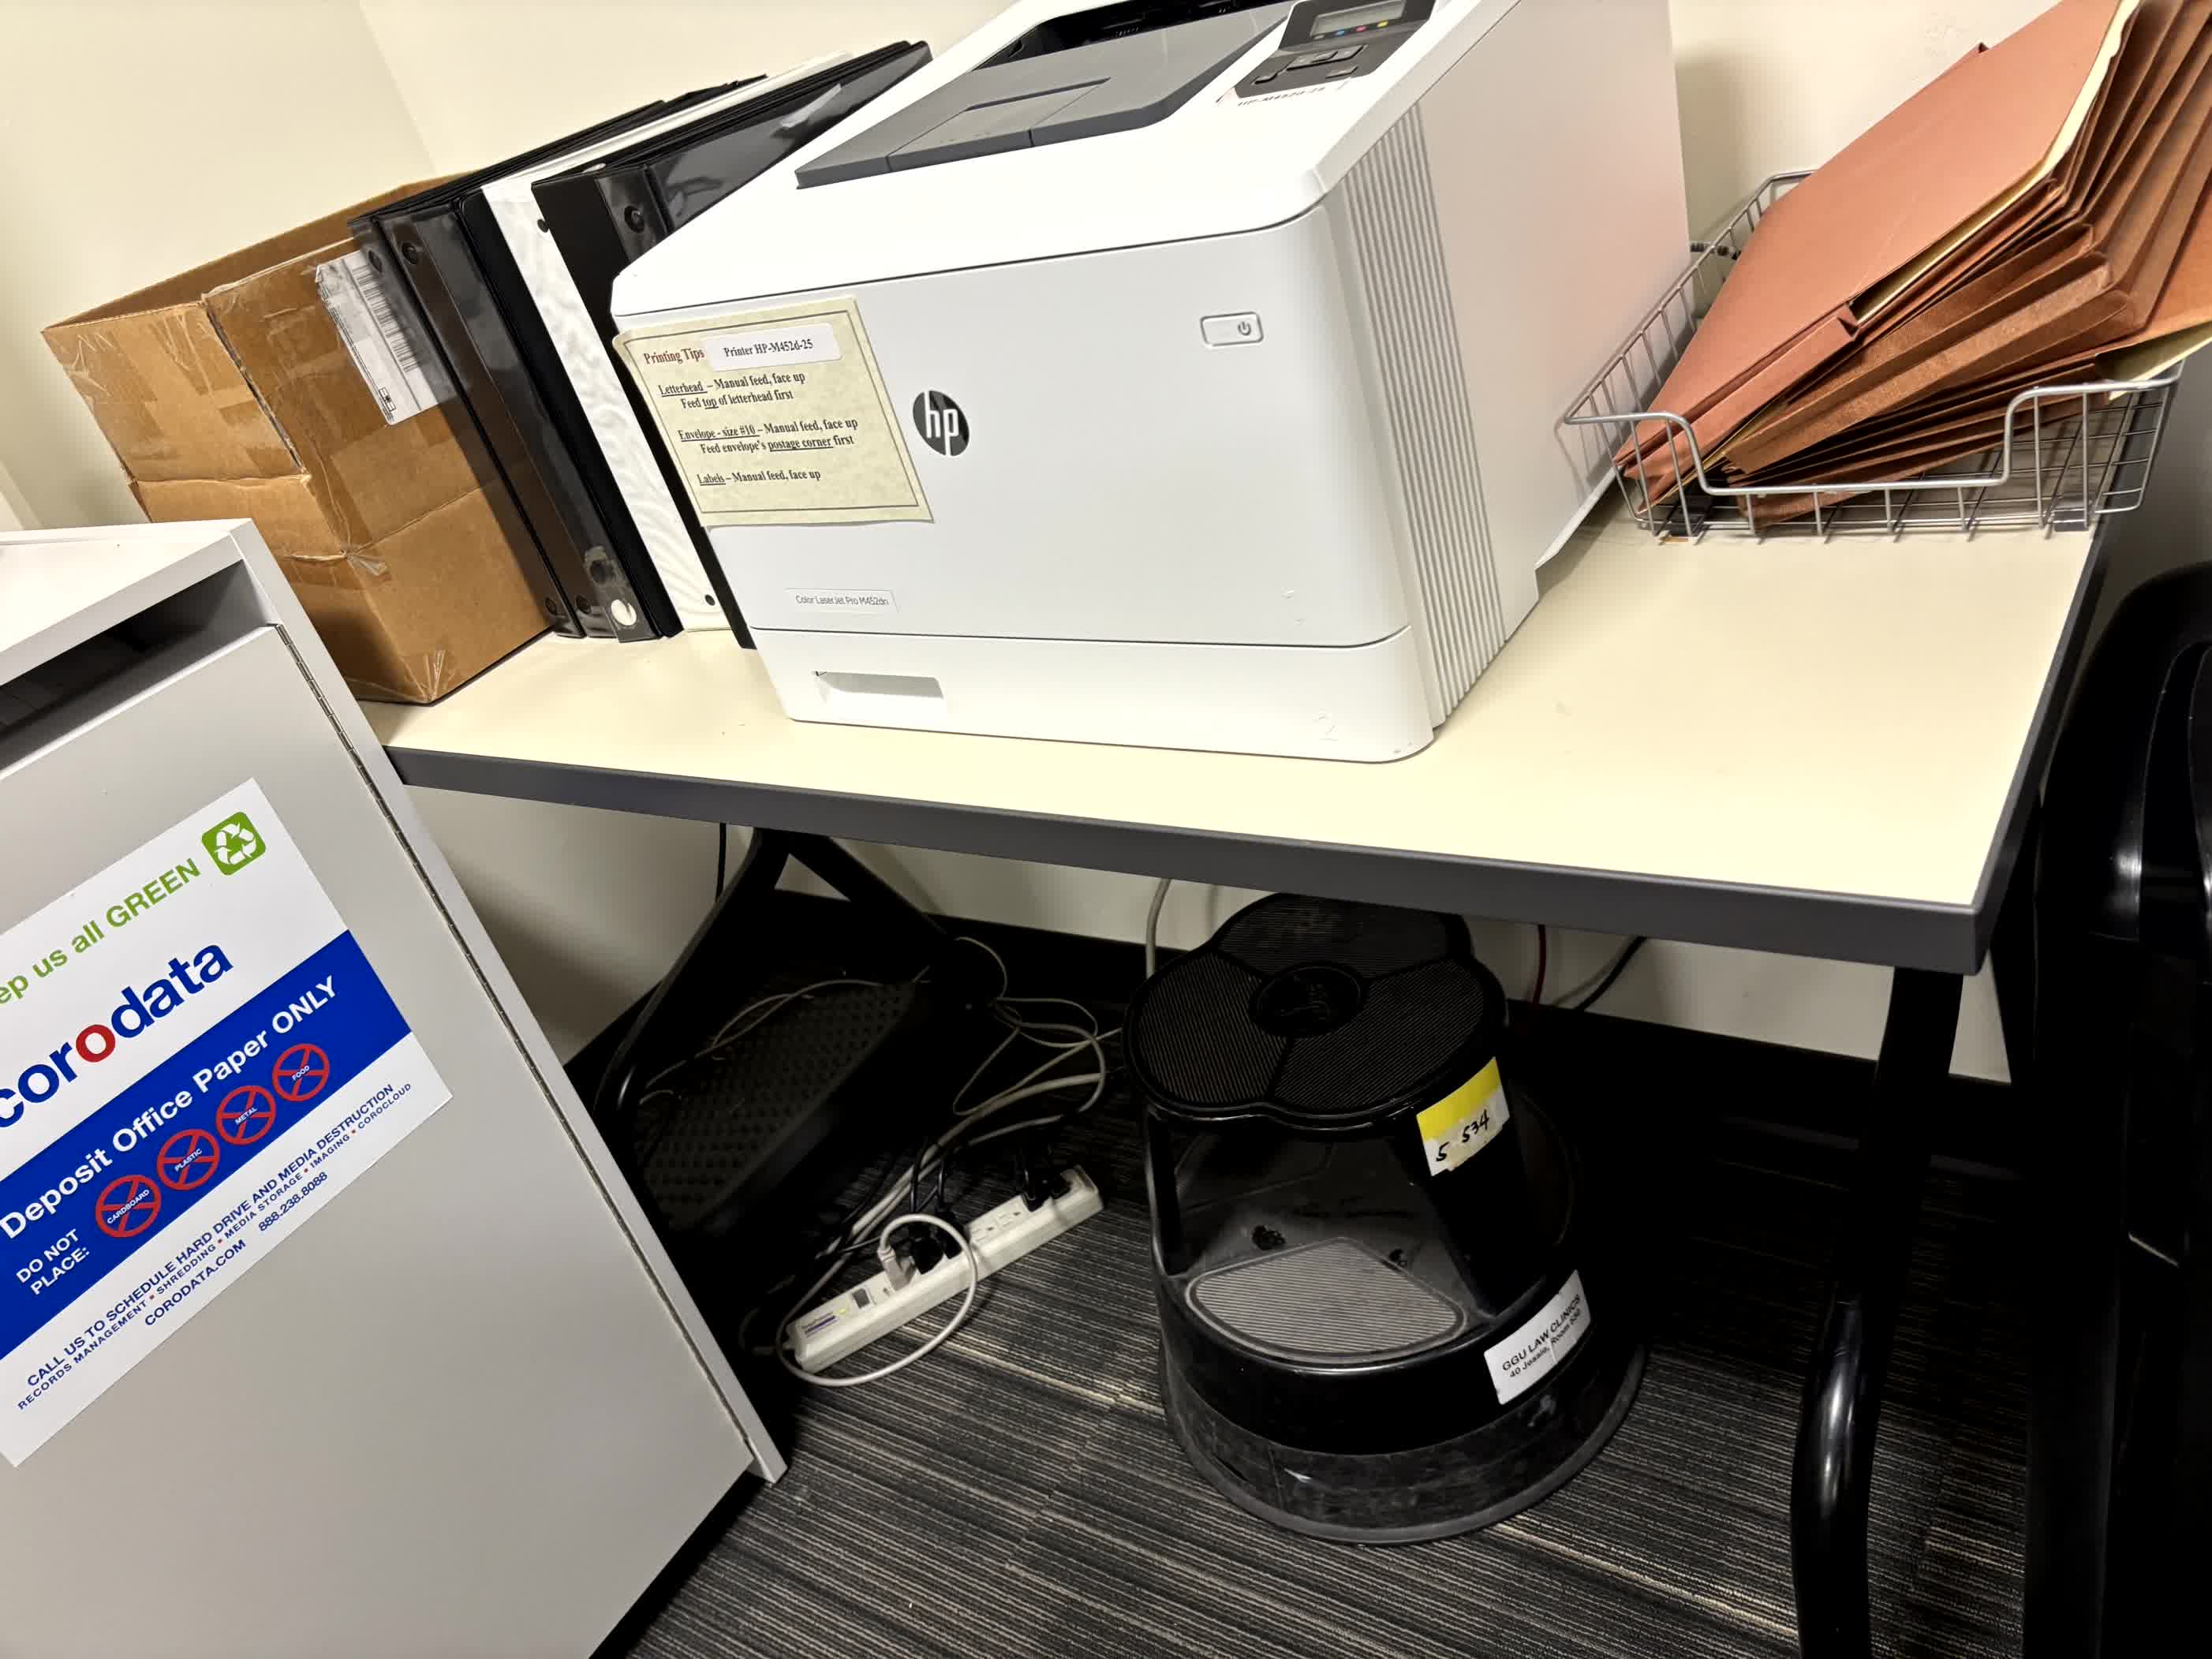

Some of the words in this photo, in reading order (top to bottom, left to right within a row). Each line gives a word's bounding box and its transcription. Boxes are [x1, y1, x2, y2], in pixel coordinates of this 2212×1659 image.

[643, 350, 683, 365] Printing
[682, 347, 705, 363] Tips
[724, 345, 753, 357] Printer
[754, 338, 814, 354] HP-M452d-25
[658, 380, 704, 396] Letterhead
[713, 376, 749, 390] Manual
[749, 375, 772, 387] feed,
[772, 374, 790, 385] face
[793, 373, 805, 384] up
[681, 398, 702, 409] Feed
[703, 397, 718, 409] top
[719, 395, 728, 405] of
[729, 391, 773, 404] letterhead
[774, 389, 794, 401] first
[678, 428, 716, 441] Envelope
[722, 427, 739, 437] size
[740, 425, 757, 435] #10
[764, 422, 800, 435] Manual
[801, 420, 824, 432] feed,
[823, 419, 843, 431] face
[845, 418, 858, 430] up
[925, 390, 959, 456] hp
[700, 443, 721, 455] Feed
[722, 439, 768, 454] envelope's
[768, 439, 801, 451] postage
[801, 437, 832, 448] corner
[832, 435, 856, 447] first
[697, 473, 726, 485] Labels
[732, 471, 766, 482] Manual
[767, 470, 788, 481] feed,
[789, 469, 808, 480] face
[809, 470, 822, 481] up
[795, 595, 814, 604] Color
[846, 596, 858, 605] Pro
[32, 949, 68, 978] us
[71, 920, 105, 953] all
[106, 858, 201, 929] GREEN
[0, 944, 234, 1128] corodata
[291, 1065, 310, 1081] FOOD
[0, 1148, 113, 1239] Deposit
[113, 1090, 192, 1152] Office
[192, 1030, 268, 1093] Paper
[272, 975, 335, 1033] ONLY
[234, 1107, 258, 1124] METAL
[1462, 1109, 1489, 1143] 534
[174, 1148, 203, 1171] PLASTIC
[106, 1189, 150, 1224] CARDBOARD
[17, 1363, 73, 1410] RECORDS
[73, 1300, 148, 1364] MANAGEMENT
[156, 1243, 217, 1295] SHREDDING
[224, 1212, 257, 1239] MEDIA
[257, 1172, 303, 1212] STORAGE
[309, 1134, 350, 1169] IMAGING
[357, 1083, 412, 1130] COROCLOUD
[27, 1354, 65, 1387] CALL
[64, 1336, 85, 1356] US
[84, 1319, 106, 1339] TO
[106, 1261, 177, 1322] SCHEDULE
[175, 1231, 213, 1265] HARD
[211, 1199, 252, 1235] DRIVE
[252, 1179, 277, 1204] AND
[278, 1148, 317, 1182] MEDIA
[316, 1083, 394, 1150] DESTRUCTION
[144, 1239, 247, 1327] CORODATA.COM
[258, 1171, 328, 1231] 888.238.8088
[16, 1258, 43, 1283] DO
[43, 1228, 79, 1262] NOT
[30, 1246, 90, 1295] PLACE:
[1502, 1349, 1526, 1371] GGU
[1528, 1329, 1549, 1352] LAW
[1550, 1294, 1580, 1332] CLINICS
